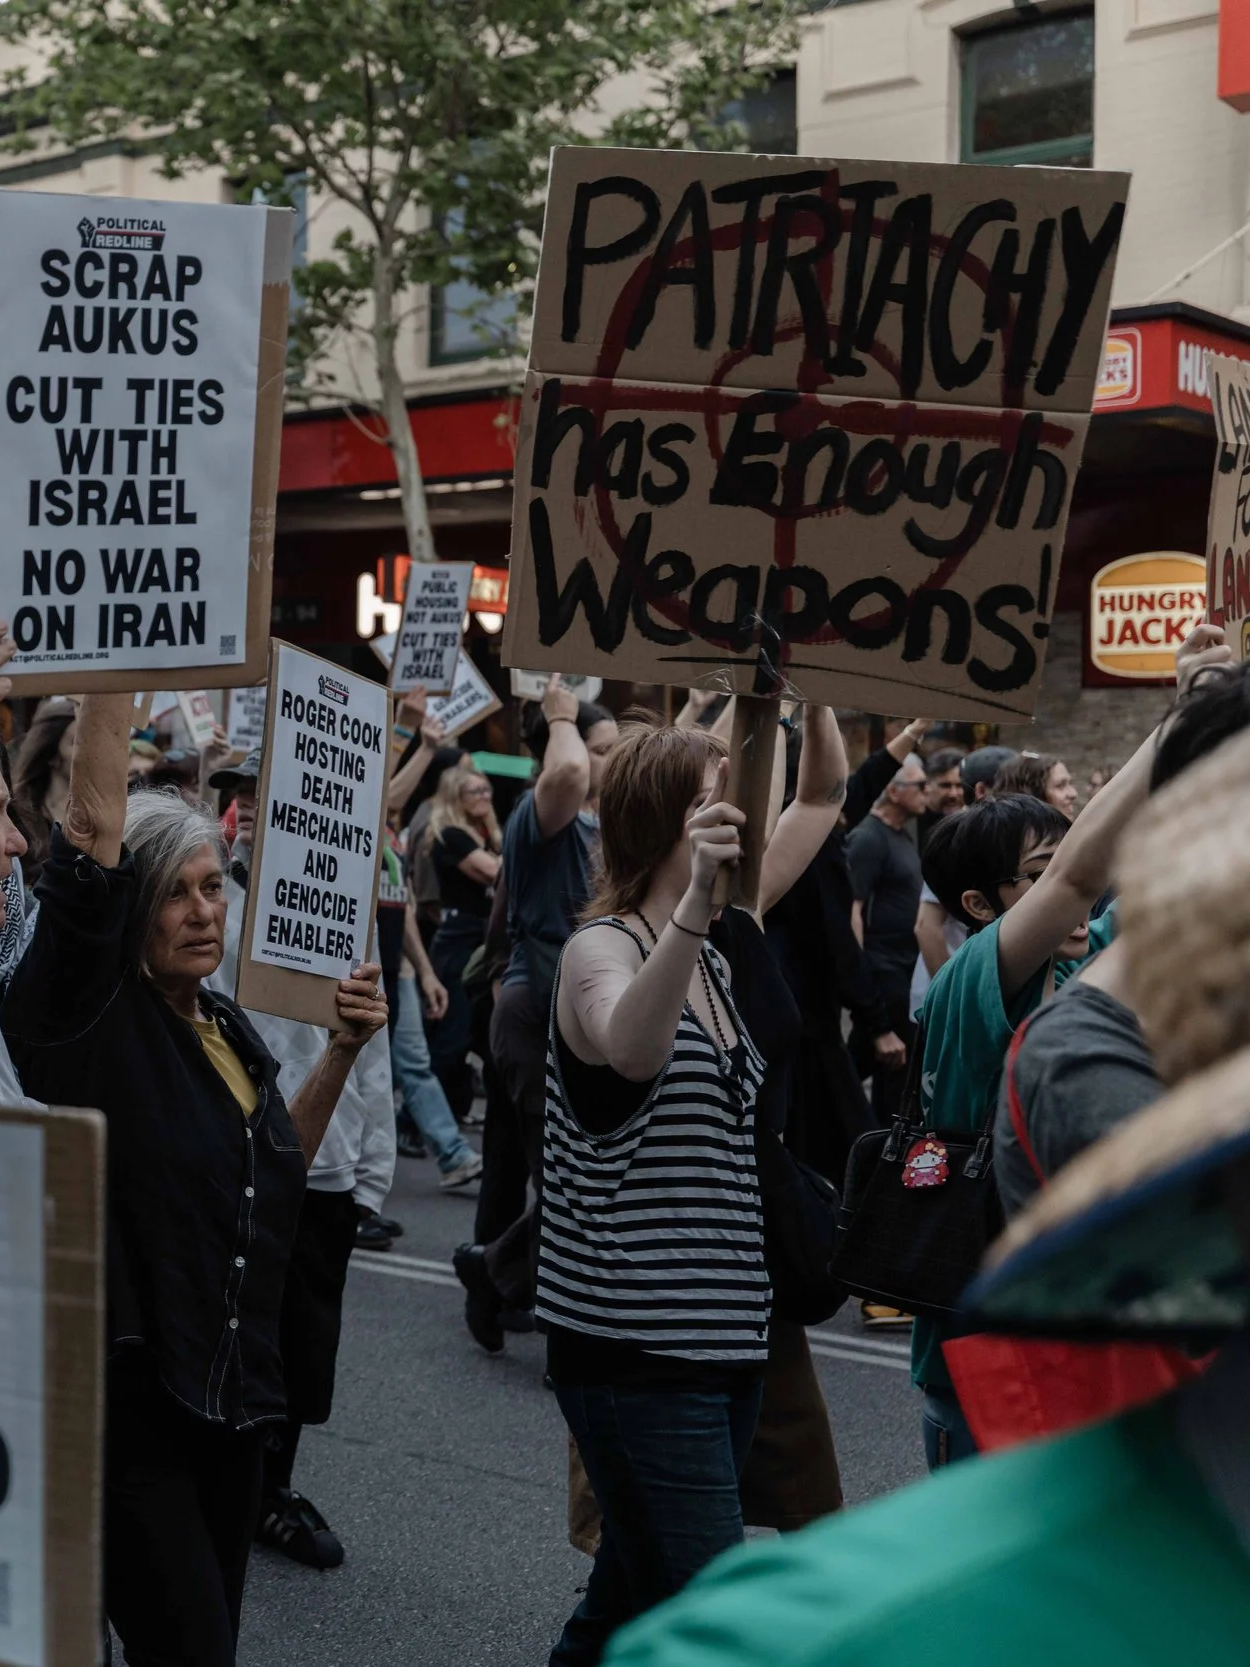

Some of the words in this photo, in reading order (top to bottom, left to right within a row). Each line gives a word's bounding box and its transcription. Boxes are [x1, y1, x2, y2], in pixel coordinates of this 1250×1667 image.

[95, 234, 153, 249] REDLINE
[96, 217, 166, 231] POLITICAL
[40, 248, 203, 302] SCRAP
[38, 305, 199, 356] AUKUS
[6, 375, 103, 424] CUT
[126, 378, 225, 425] TIES
[55, 428, 178, 475] WITH
[530, 377, 695, 500] has
[709, 388, 1068, 559] Enough
[28, 479, 197, 526] ISRAEL
[22, 548, 86, 596] NO
[99, 547, 201, 594] WAR
[421, 581, 458, 593] PUBLIC
[406, 611, 426, 624] NOT
[430, 611, 462, 624] AUKUS
[415, 597, 459, 609] HOUSING
[528, 497, 1052, 696] Weapons!
[1099, 591, 1207, 614] HUNGRY
[12, 605, 75, 652] ON
[98, 601, 207, 650] IRAN
[401, 632, 428, 647] CUT
[433, 632, 458, 647] TIES
[1099, 616, 1205, 646] JACK'
[8, 652, 109, 663] ACT@POLITICALREDLINE.ORG
[401, 664, 444, 680] ISRAEL
[412, 649, 444, 663] WITH
[325, 676, 350, 694] POLITICAL
[281, 689, 336, 737] ROGER
[340, 714, 382, 754] COOK
[294, 731, 365, 783] HOSTING
[301, 771, 354, 815] DEATH
[271, 799, 372, 858] MERCHANTS
[303, 848, 338, 883] AND
[274, 878, 357, 926] GENOCIDE
[266, 913, 354, 961] ENABLERS
